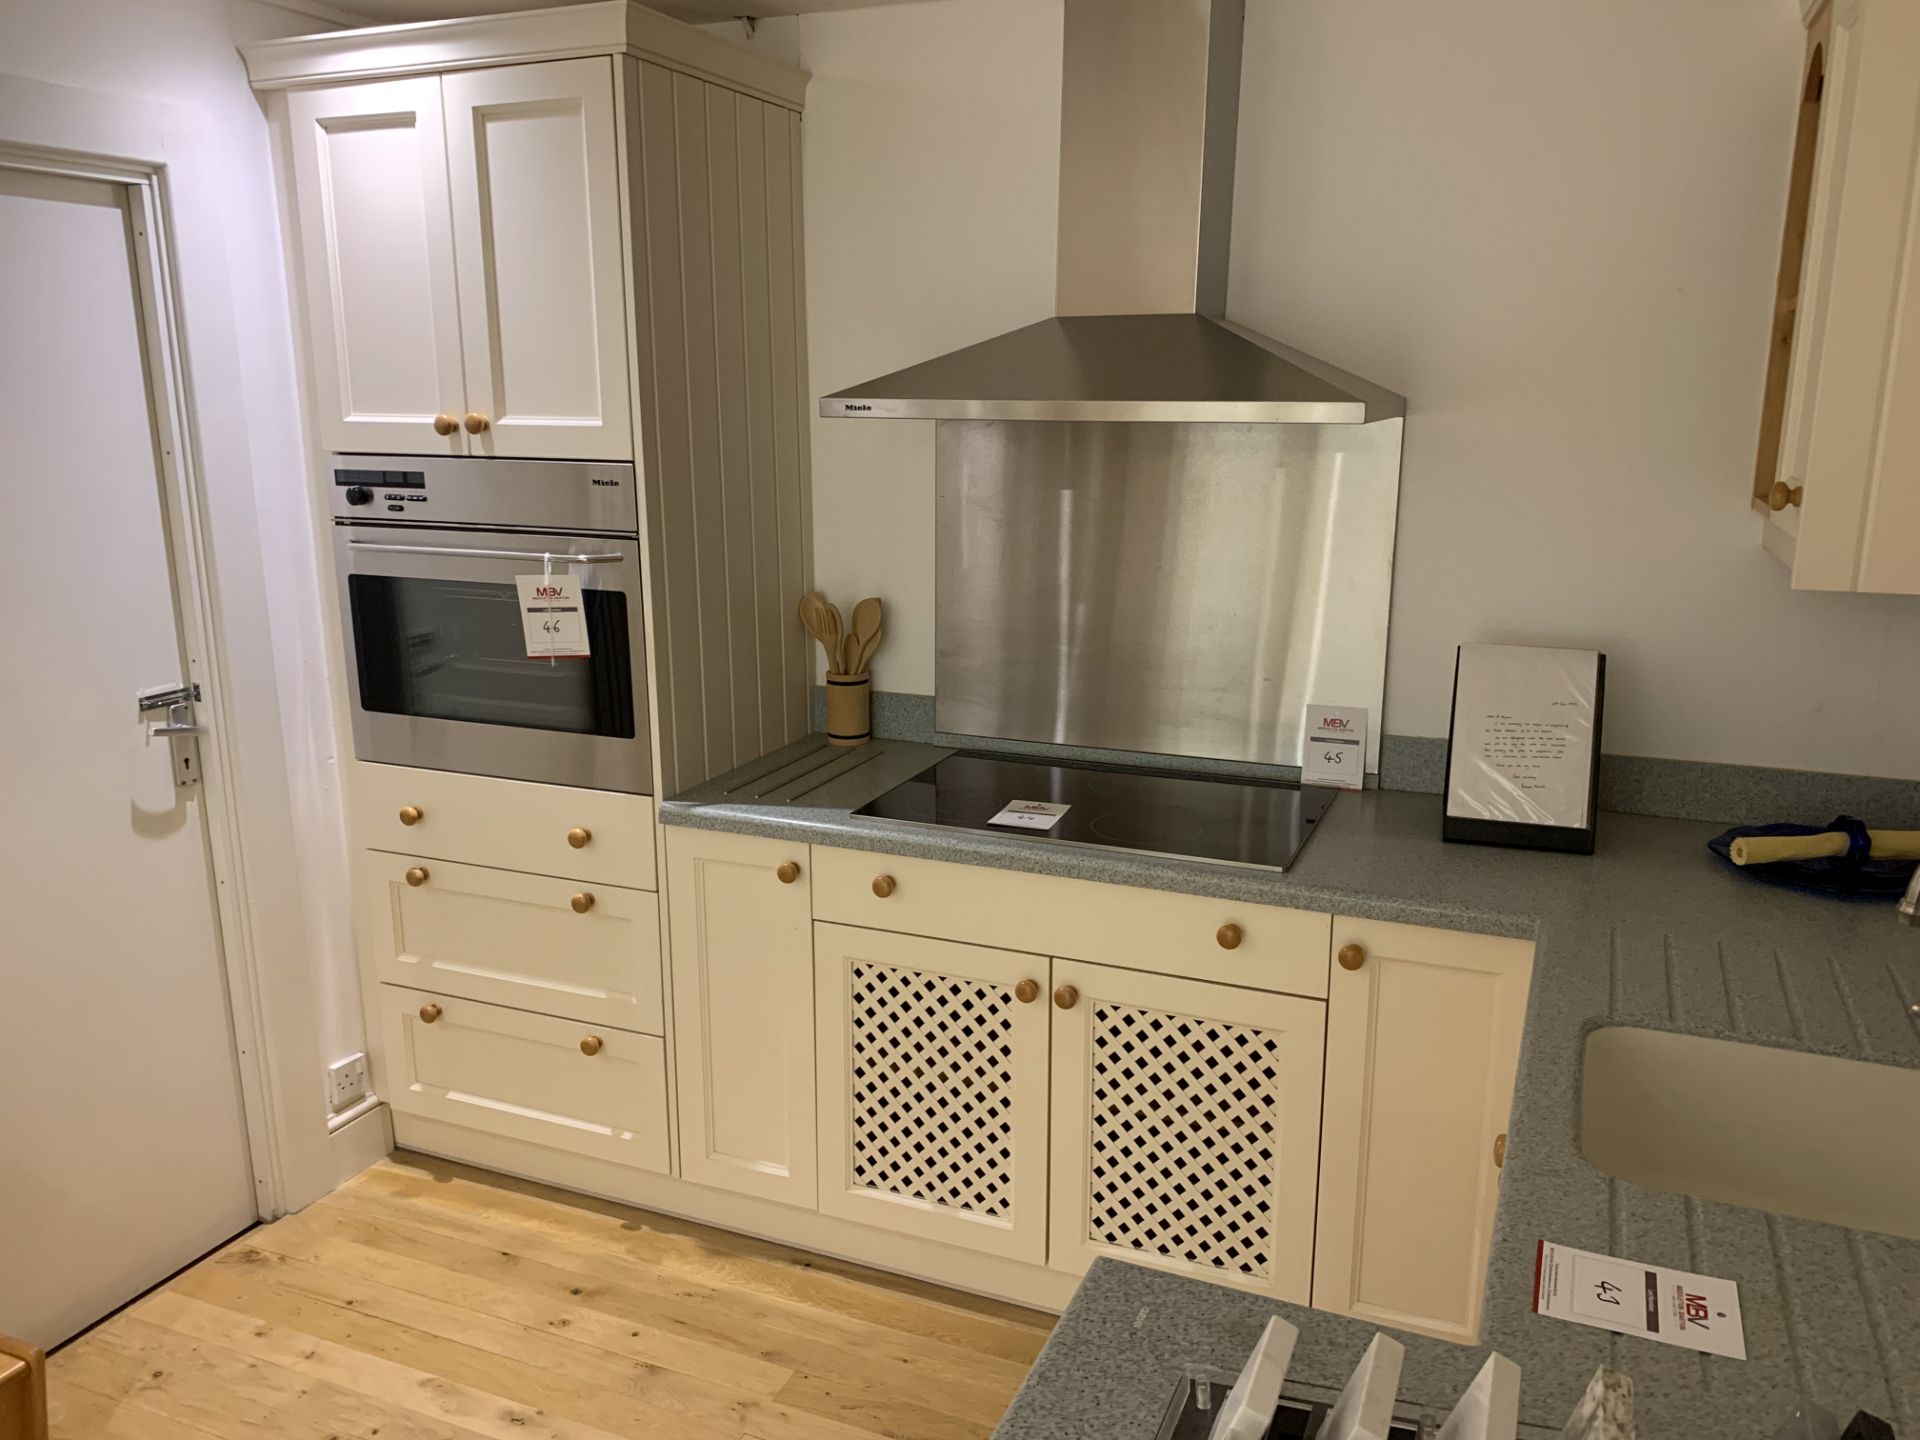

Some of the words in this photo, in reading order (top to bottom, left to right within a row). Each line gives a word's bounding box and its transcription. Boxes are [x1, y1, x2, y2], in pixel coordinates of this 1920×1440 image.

[592, 479, 620, 487] Miele
[543, 620, 561, 633] 46
[1322, 717, 1350, 729] MBV
[1324, 751, 1344, 764] 45
[1685, 1293, 1710, 1330] MBV
